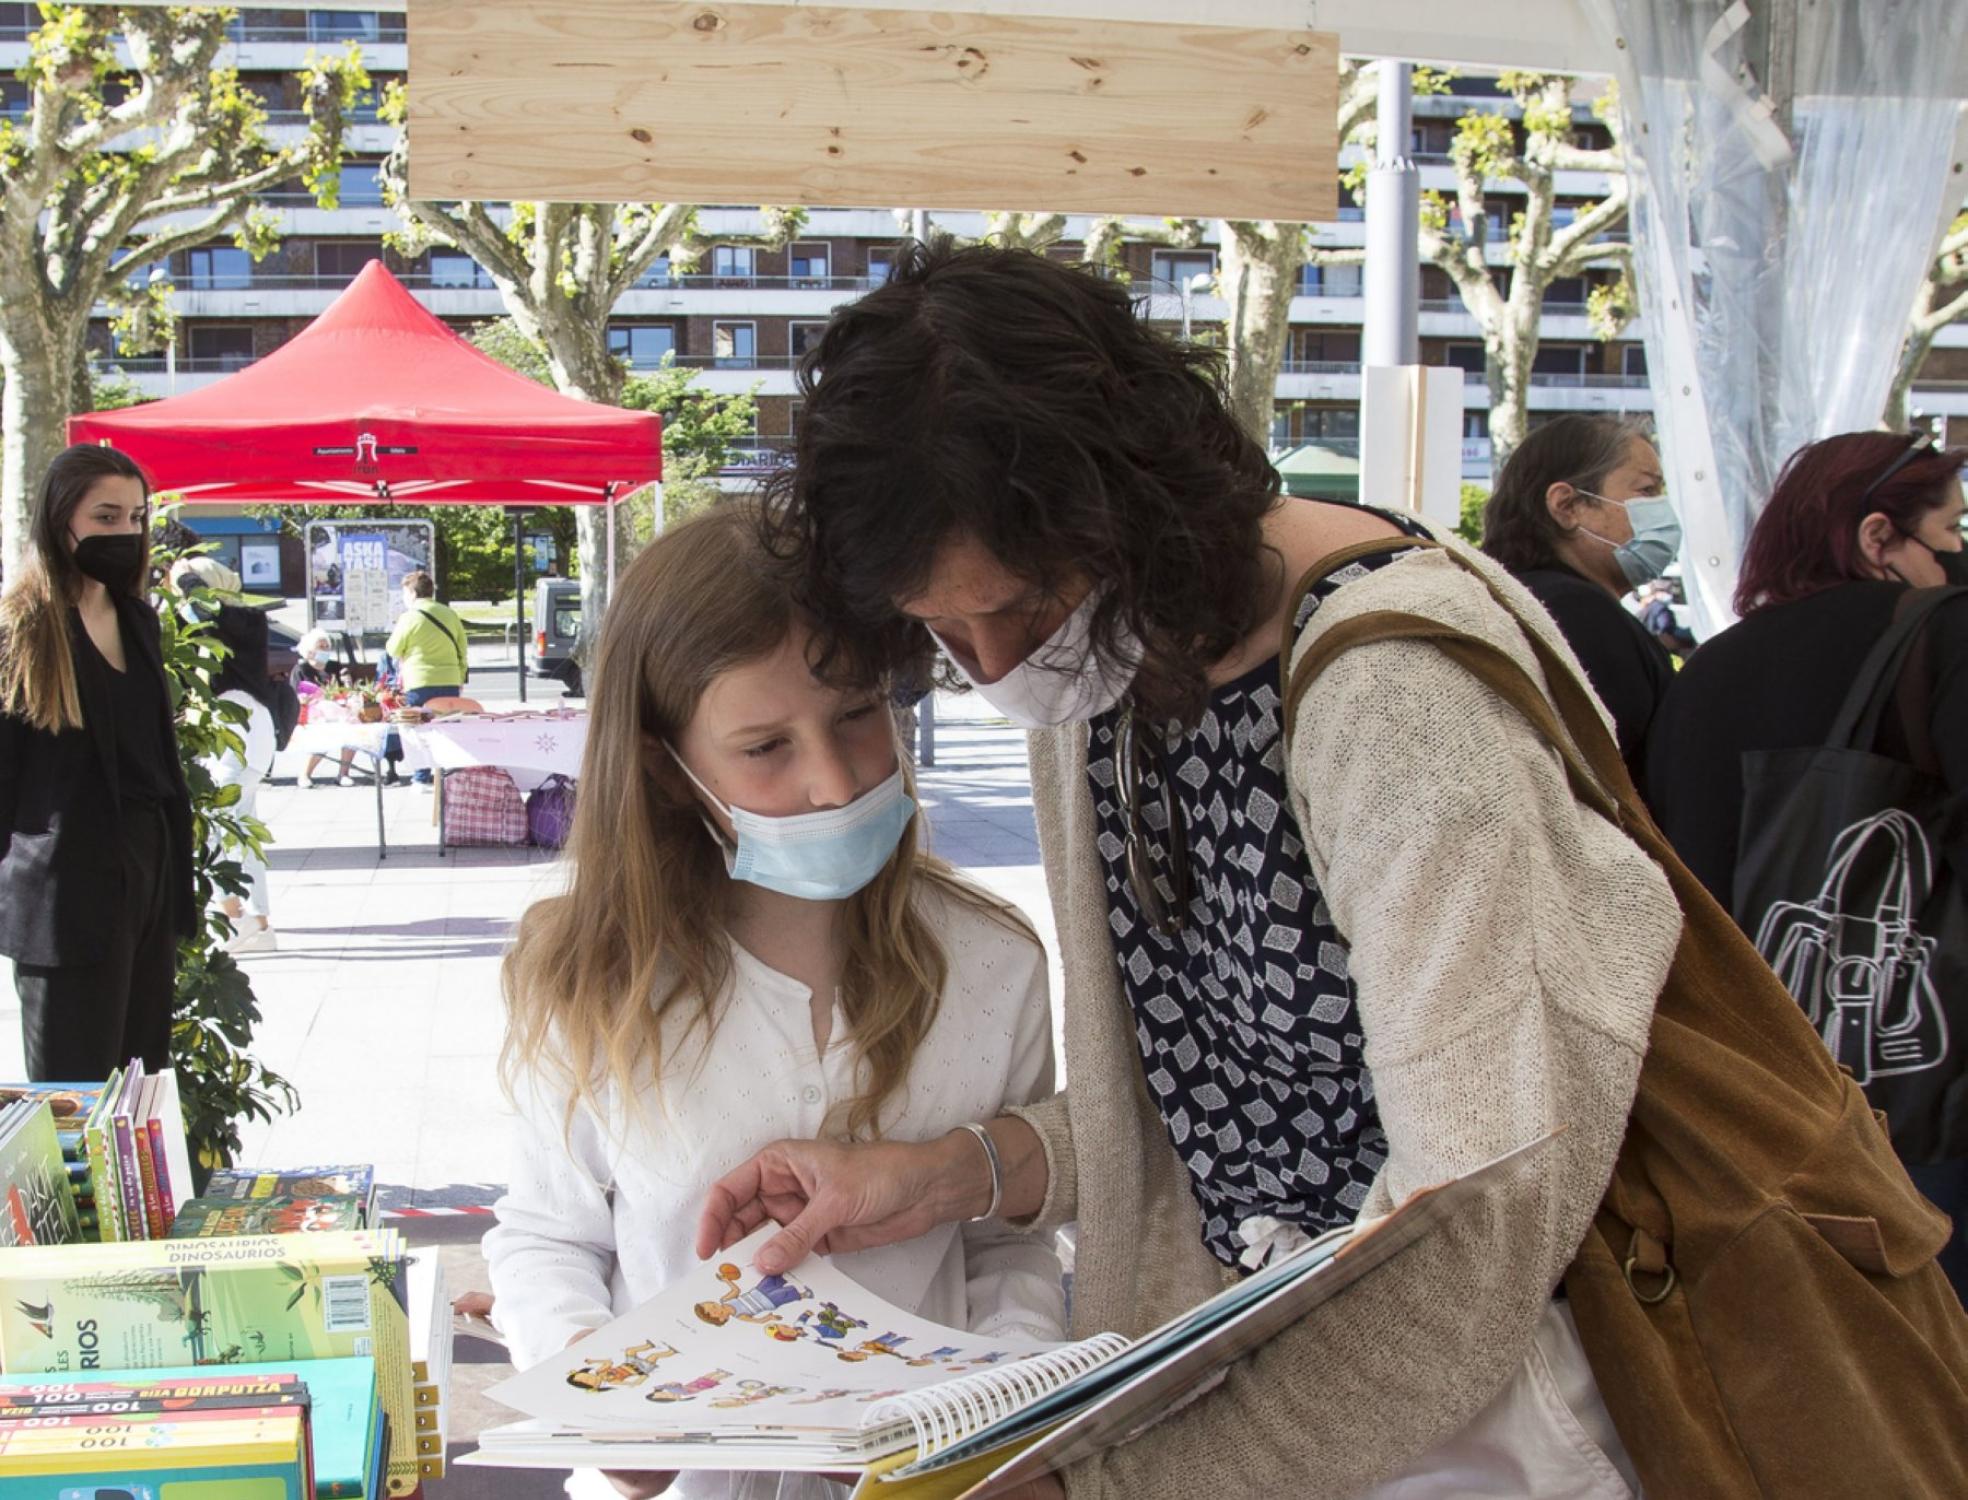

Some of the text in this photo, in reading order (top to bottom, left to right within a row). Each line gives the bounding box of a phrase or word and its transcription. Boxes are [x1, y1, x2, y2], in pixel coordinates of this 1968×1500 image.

[344, 541, 384, 557] ASKA
[169, 1247, 287, 1263] DINOSAURIOS
[34, 1392, 80, 1404] 100
[92, 1401, 140, 1413] 100
